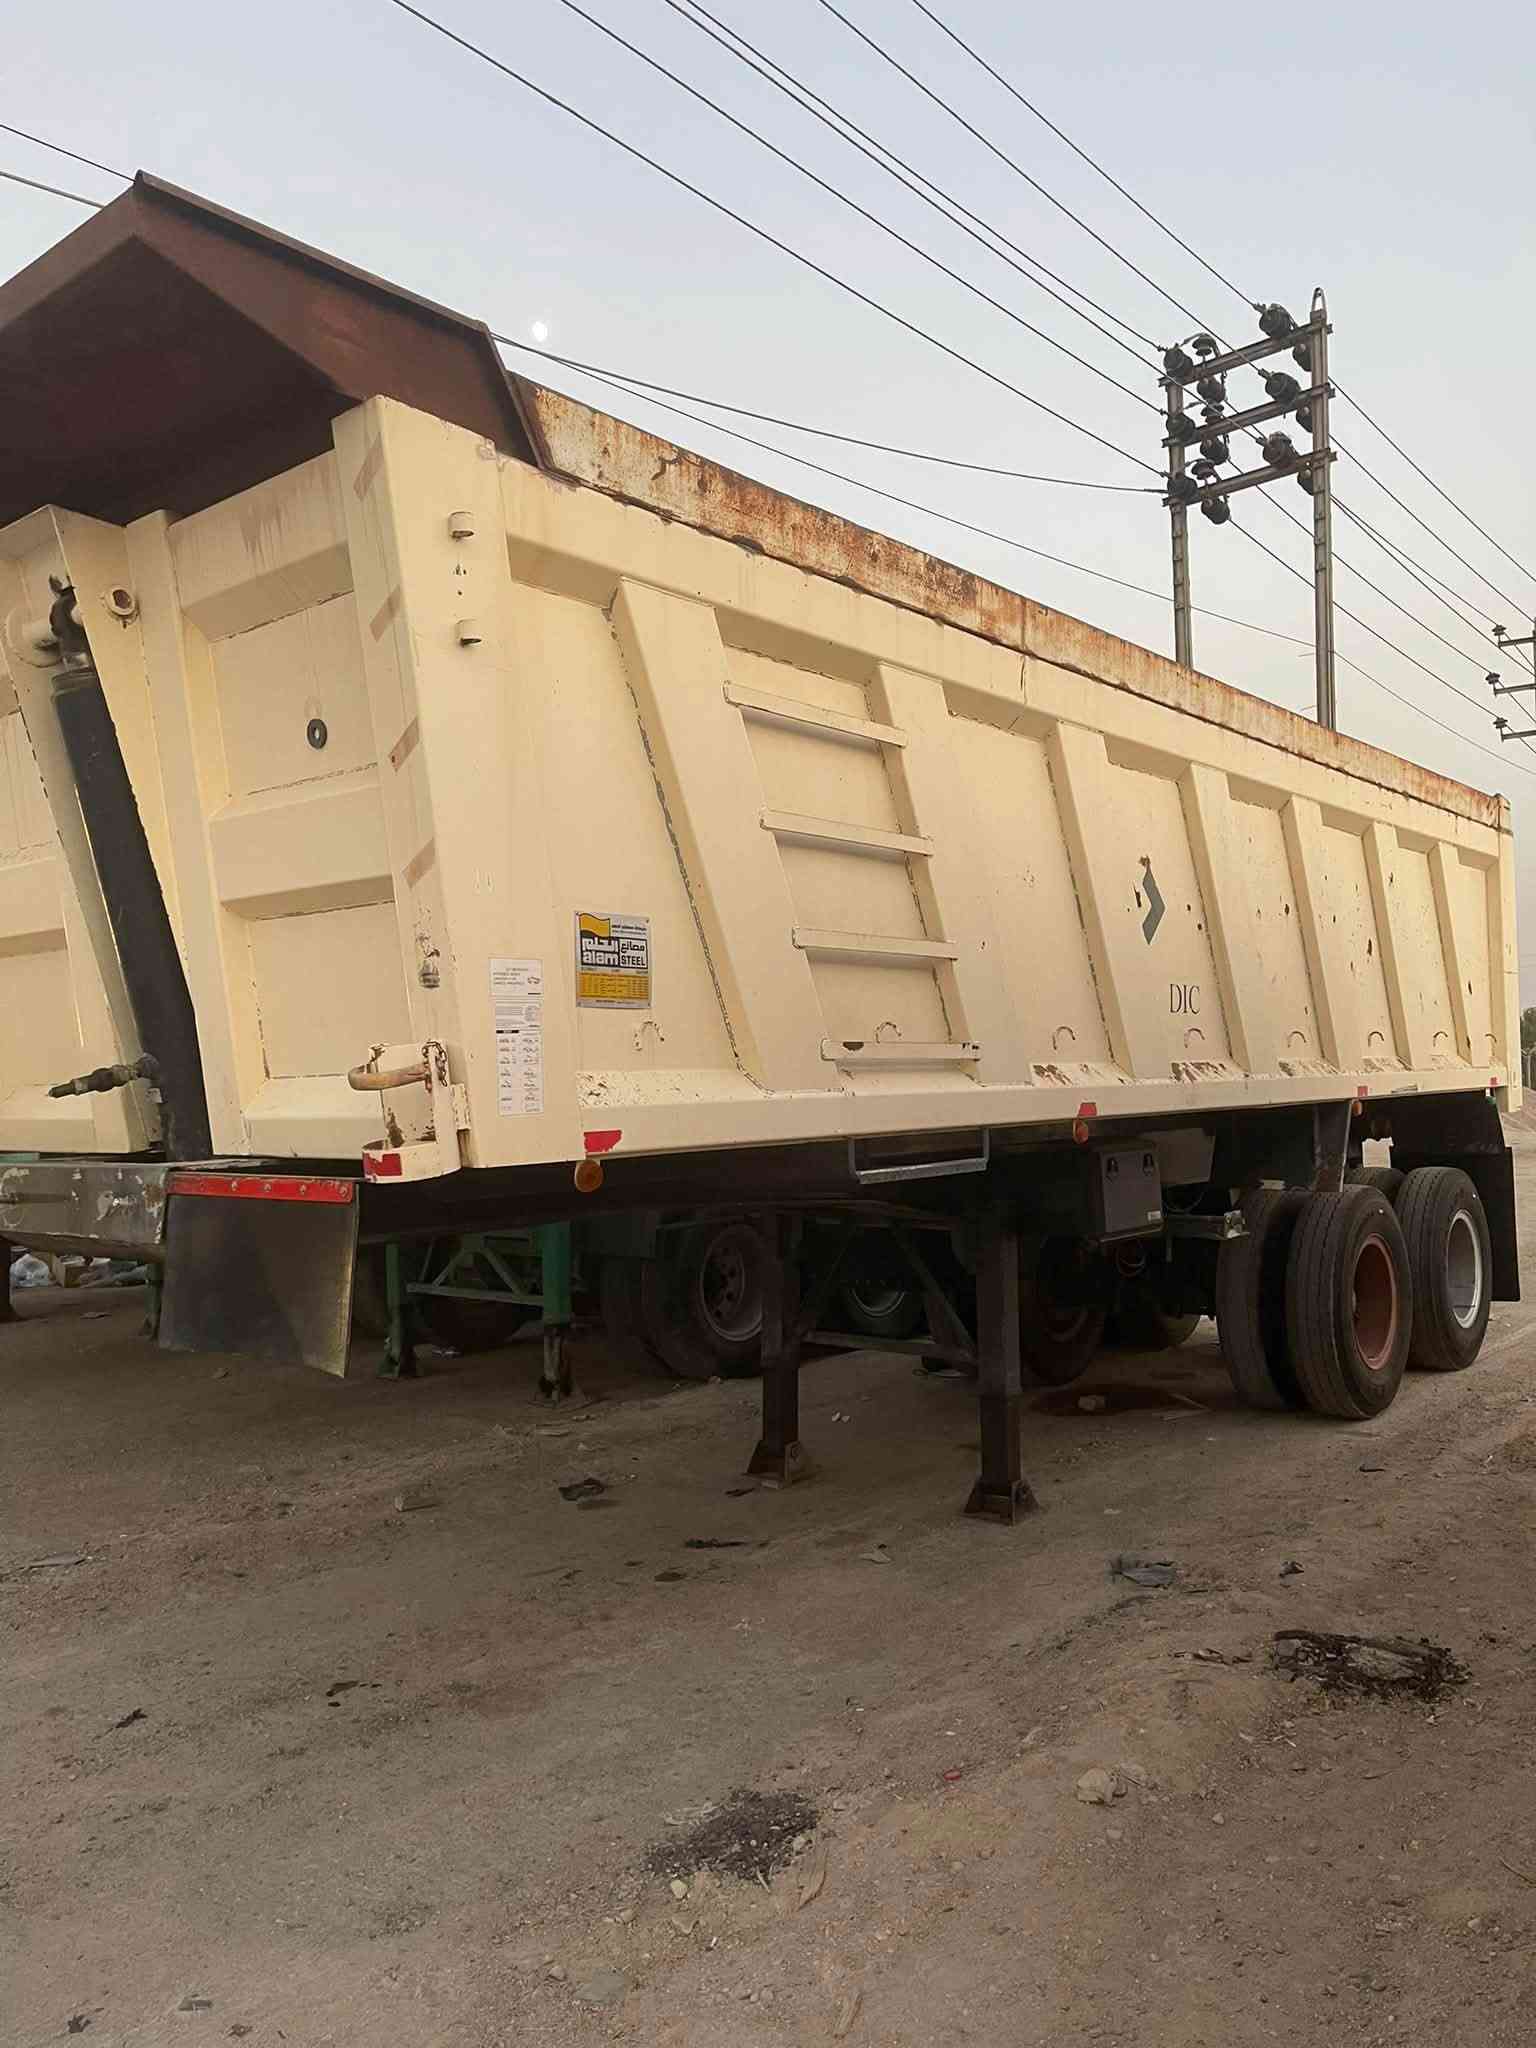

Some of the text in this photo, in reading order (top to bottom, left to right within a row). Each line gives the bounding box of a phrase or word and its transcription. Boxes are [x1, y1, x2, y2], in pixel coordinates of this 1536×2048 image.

[582, 950, 646, 967] alam STEEL
[1170, 983, 1200, 1015] DIC
